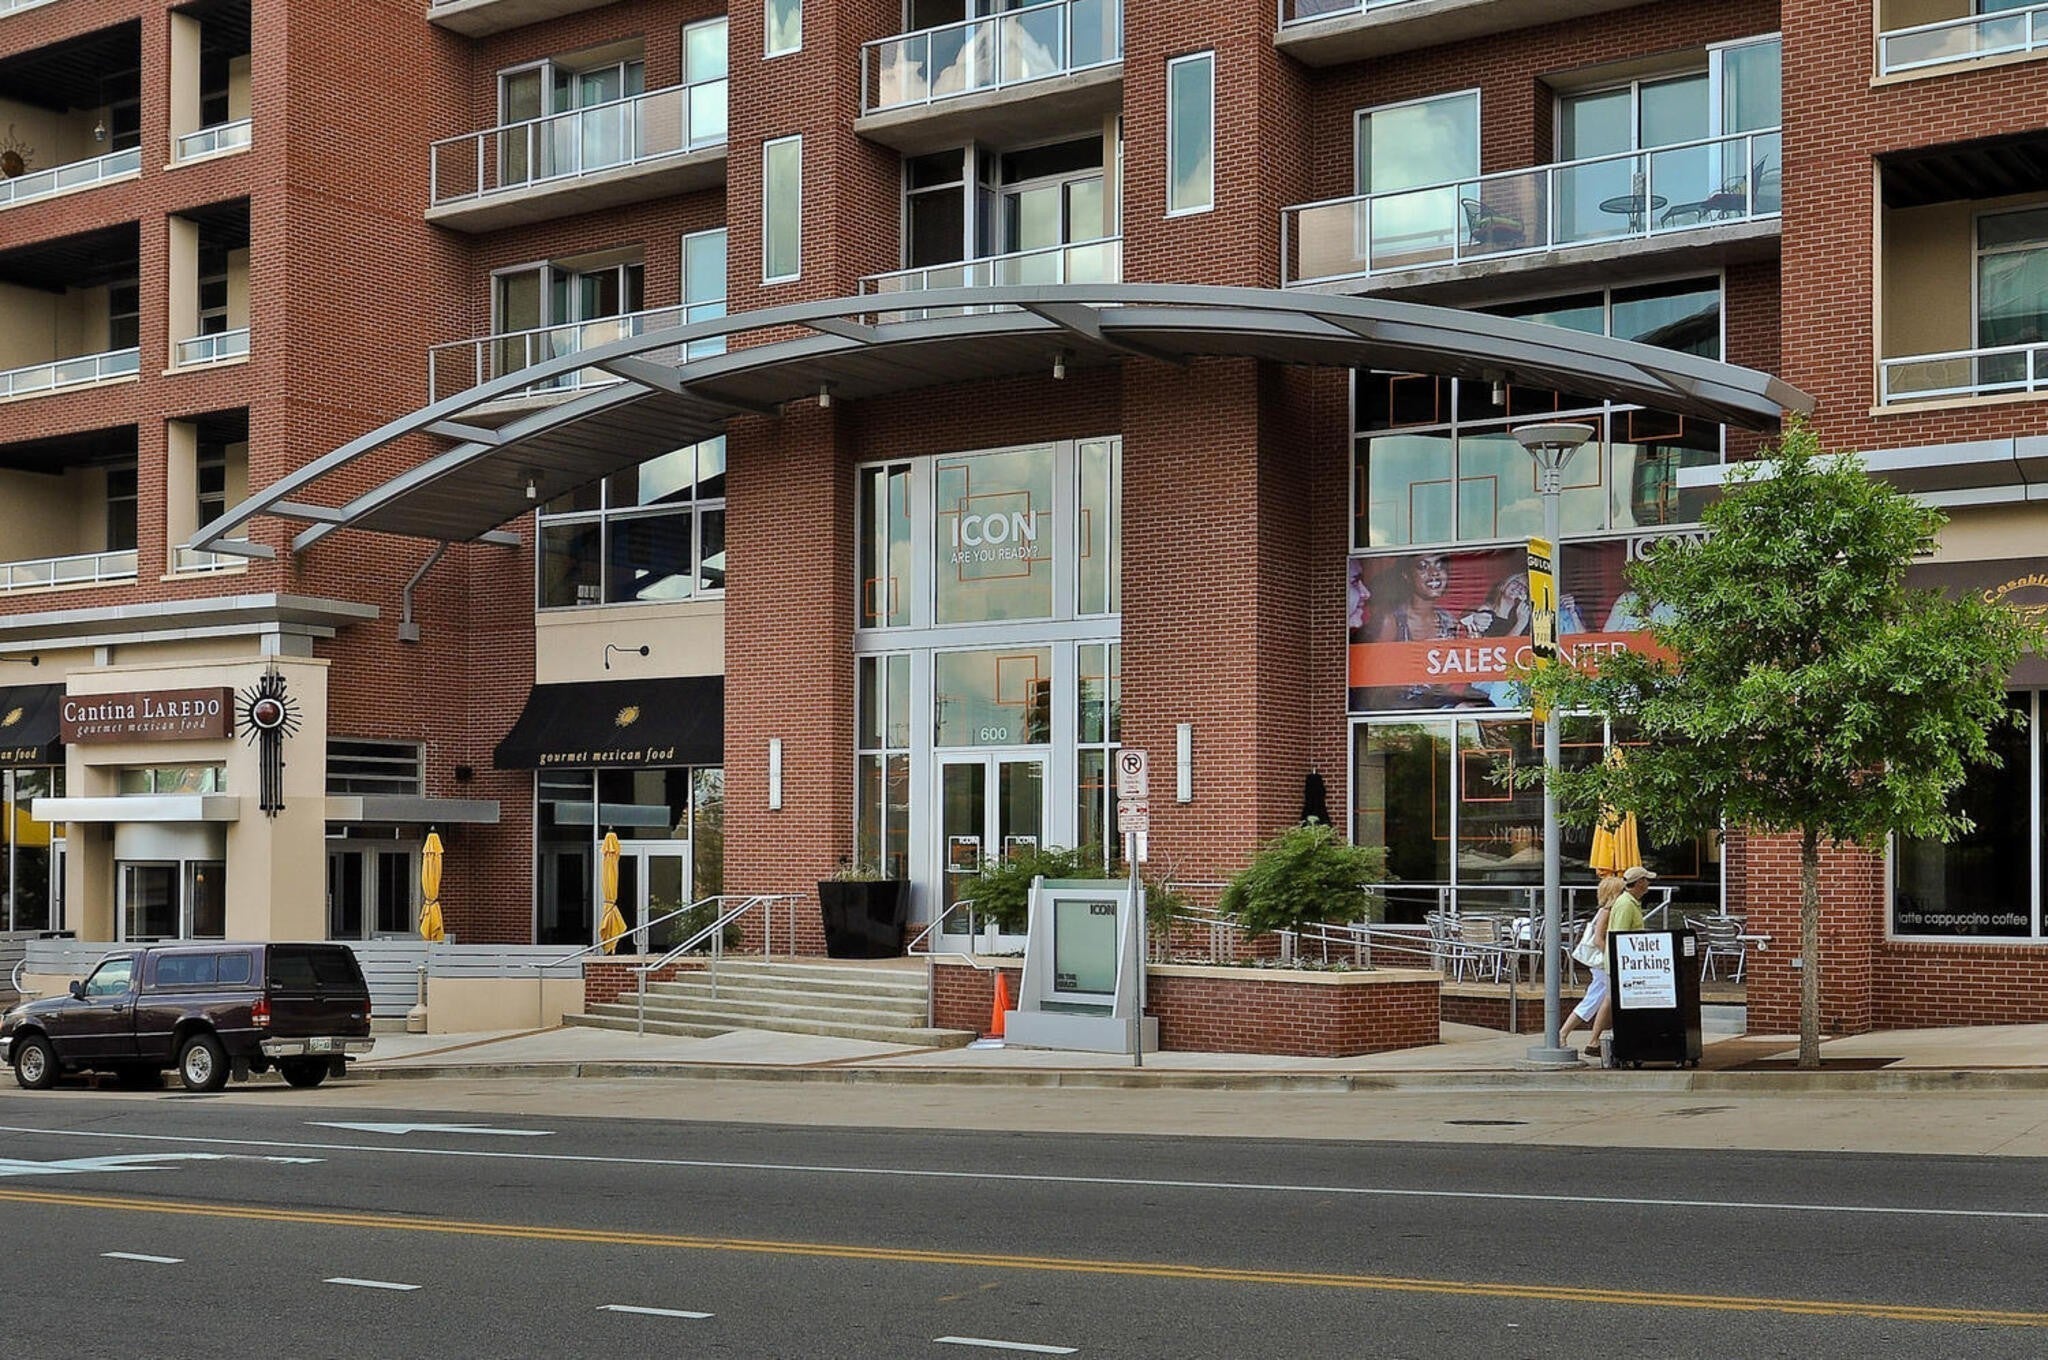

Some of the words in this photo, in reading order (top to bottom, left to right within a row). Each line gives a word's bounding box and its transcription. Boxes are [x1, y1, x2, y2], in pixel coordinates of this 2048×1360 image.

[952, 510, 1037, 547] ICON
[951, 551, 970, 564] ARE
[973, 549, 995, 562] YOU
[999, 546, 1039, 560] READY?
[1426, 647, 1507, 674] SALES
[1514, 642, 1629, 671] CNTER
[63, 701, 136, 722] Cantina
[142, 698, 220, 718] LAREDO
[76, 724, 123, 737] gourmet
[127, 720, 175, 732] mexican
[178, 717, 207, 733] food
[980, 727, 1007, 741] 600
[14, 746, 37, 762] food
[539, 751, 588, 766] gourmet
[592, 750, 642, 762] mexican
[645, 747, 675, 763] food
[1089, 904, 1116, 916] ICON
[1924, 912, 1990, 927] cappuccino
[1991, 912, 2029, 926] coffee
[1629, 936, 1661, 952] Valet
[1621, 954, 1671, 974] Parking
